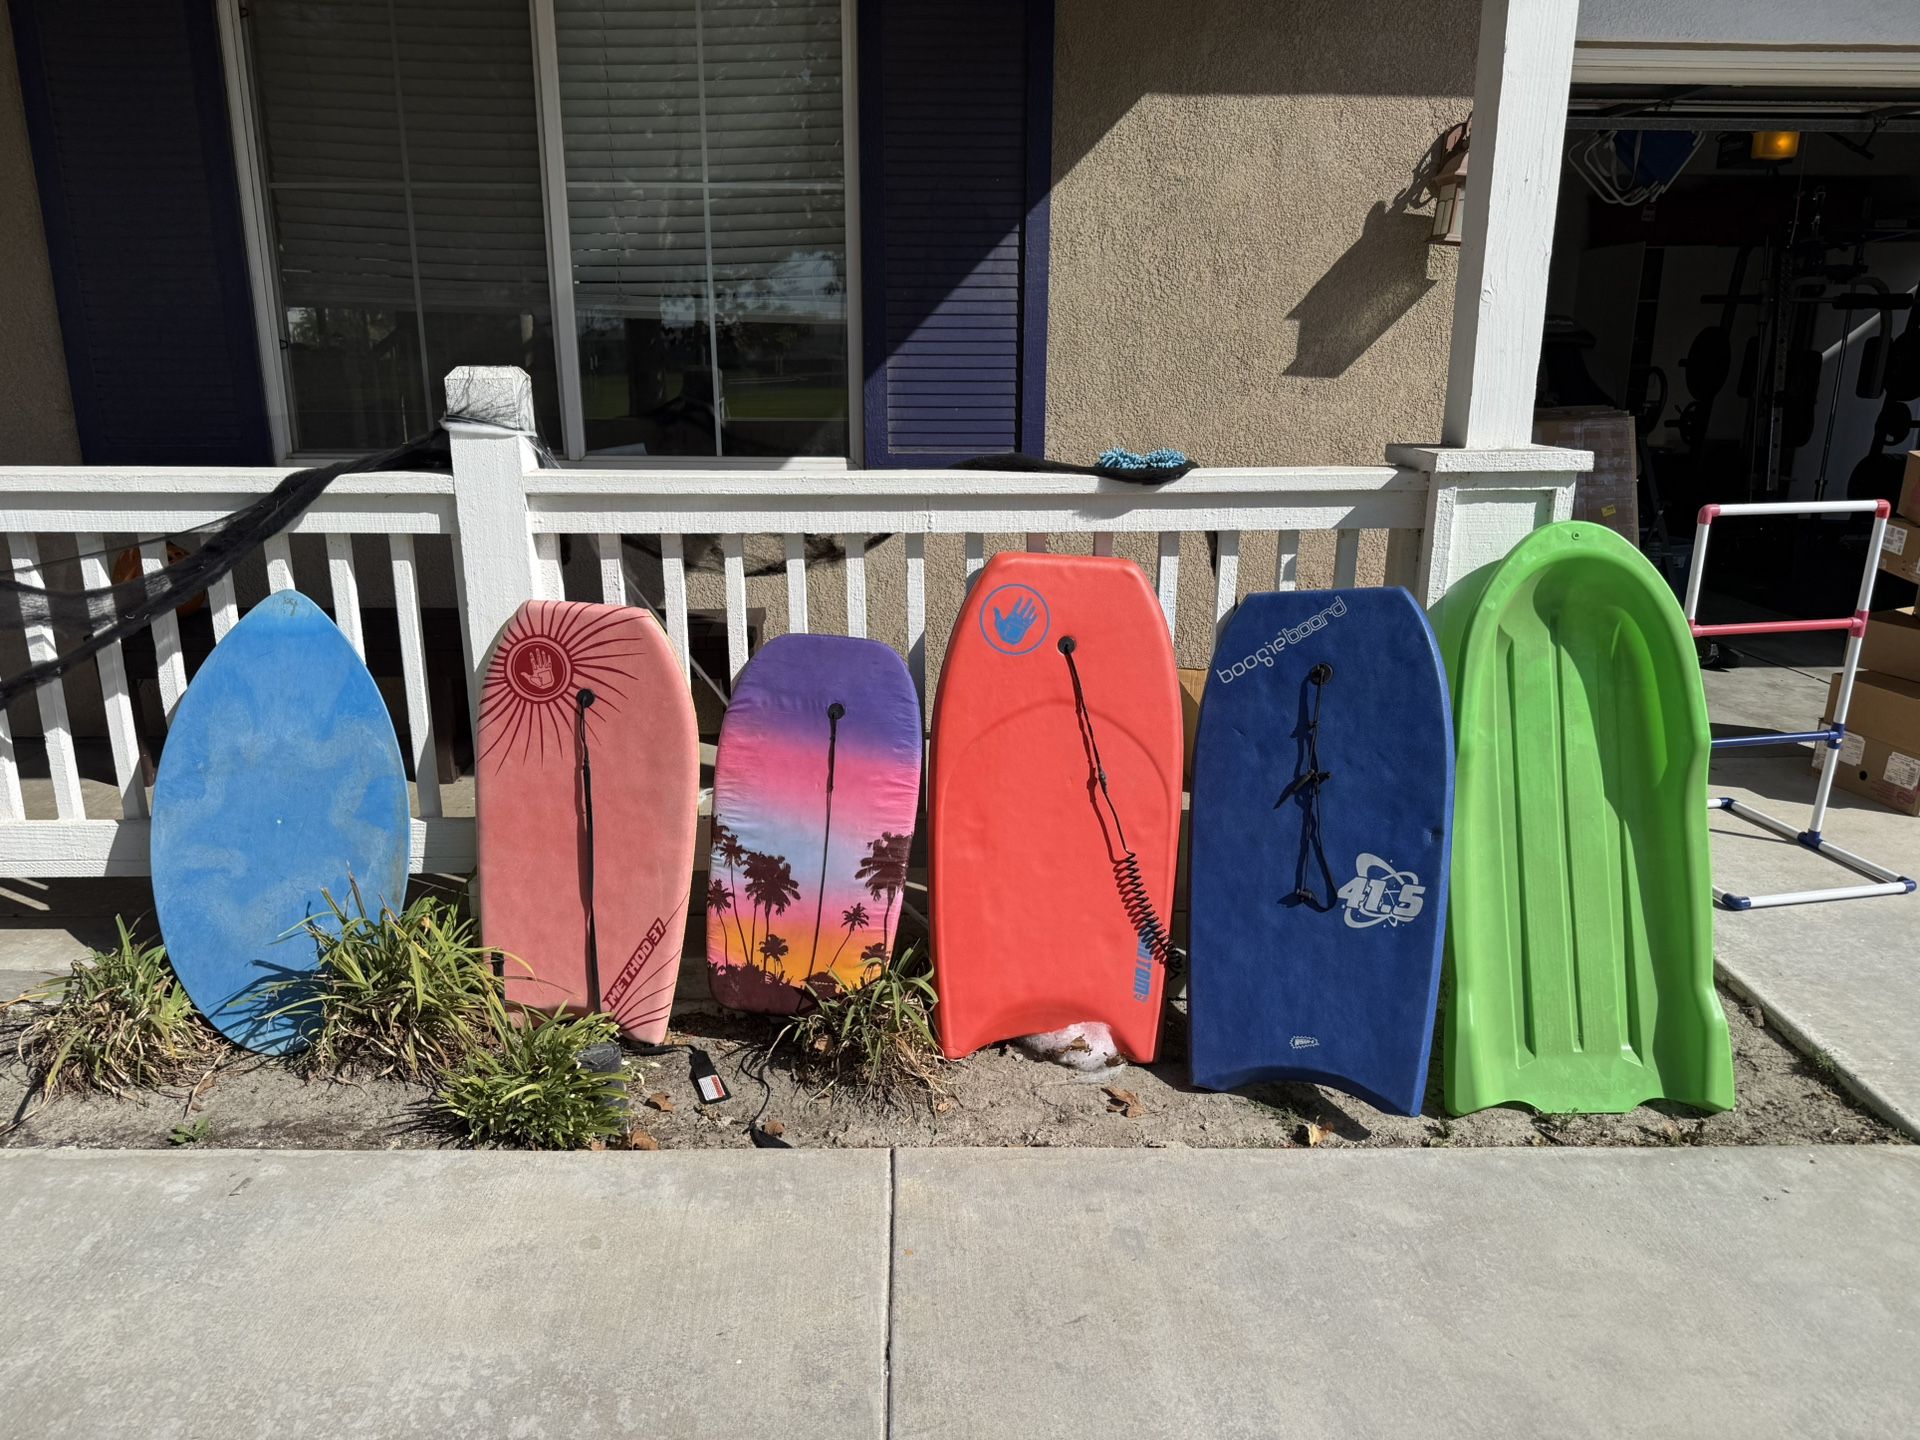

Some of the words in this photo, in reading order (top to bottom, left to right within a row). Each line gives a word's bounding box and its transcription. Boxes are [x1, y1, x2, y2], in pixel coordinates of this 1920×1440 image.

[1337, 876, 1426, 918] 41.5
[605, 939, 654, 1007] METHOD
[648, 918, 666, 946] 37
